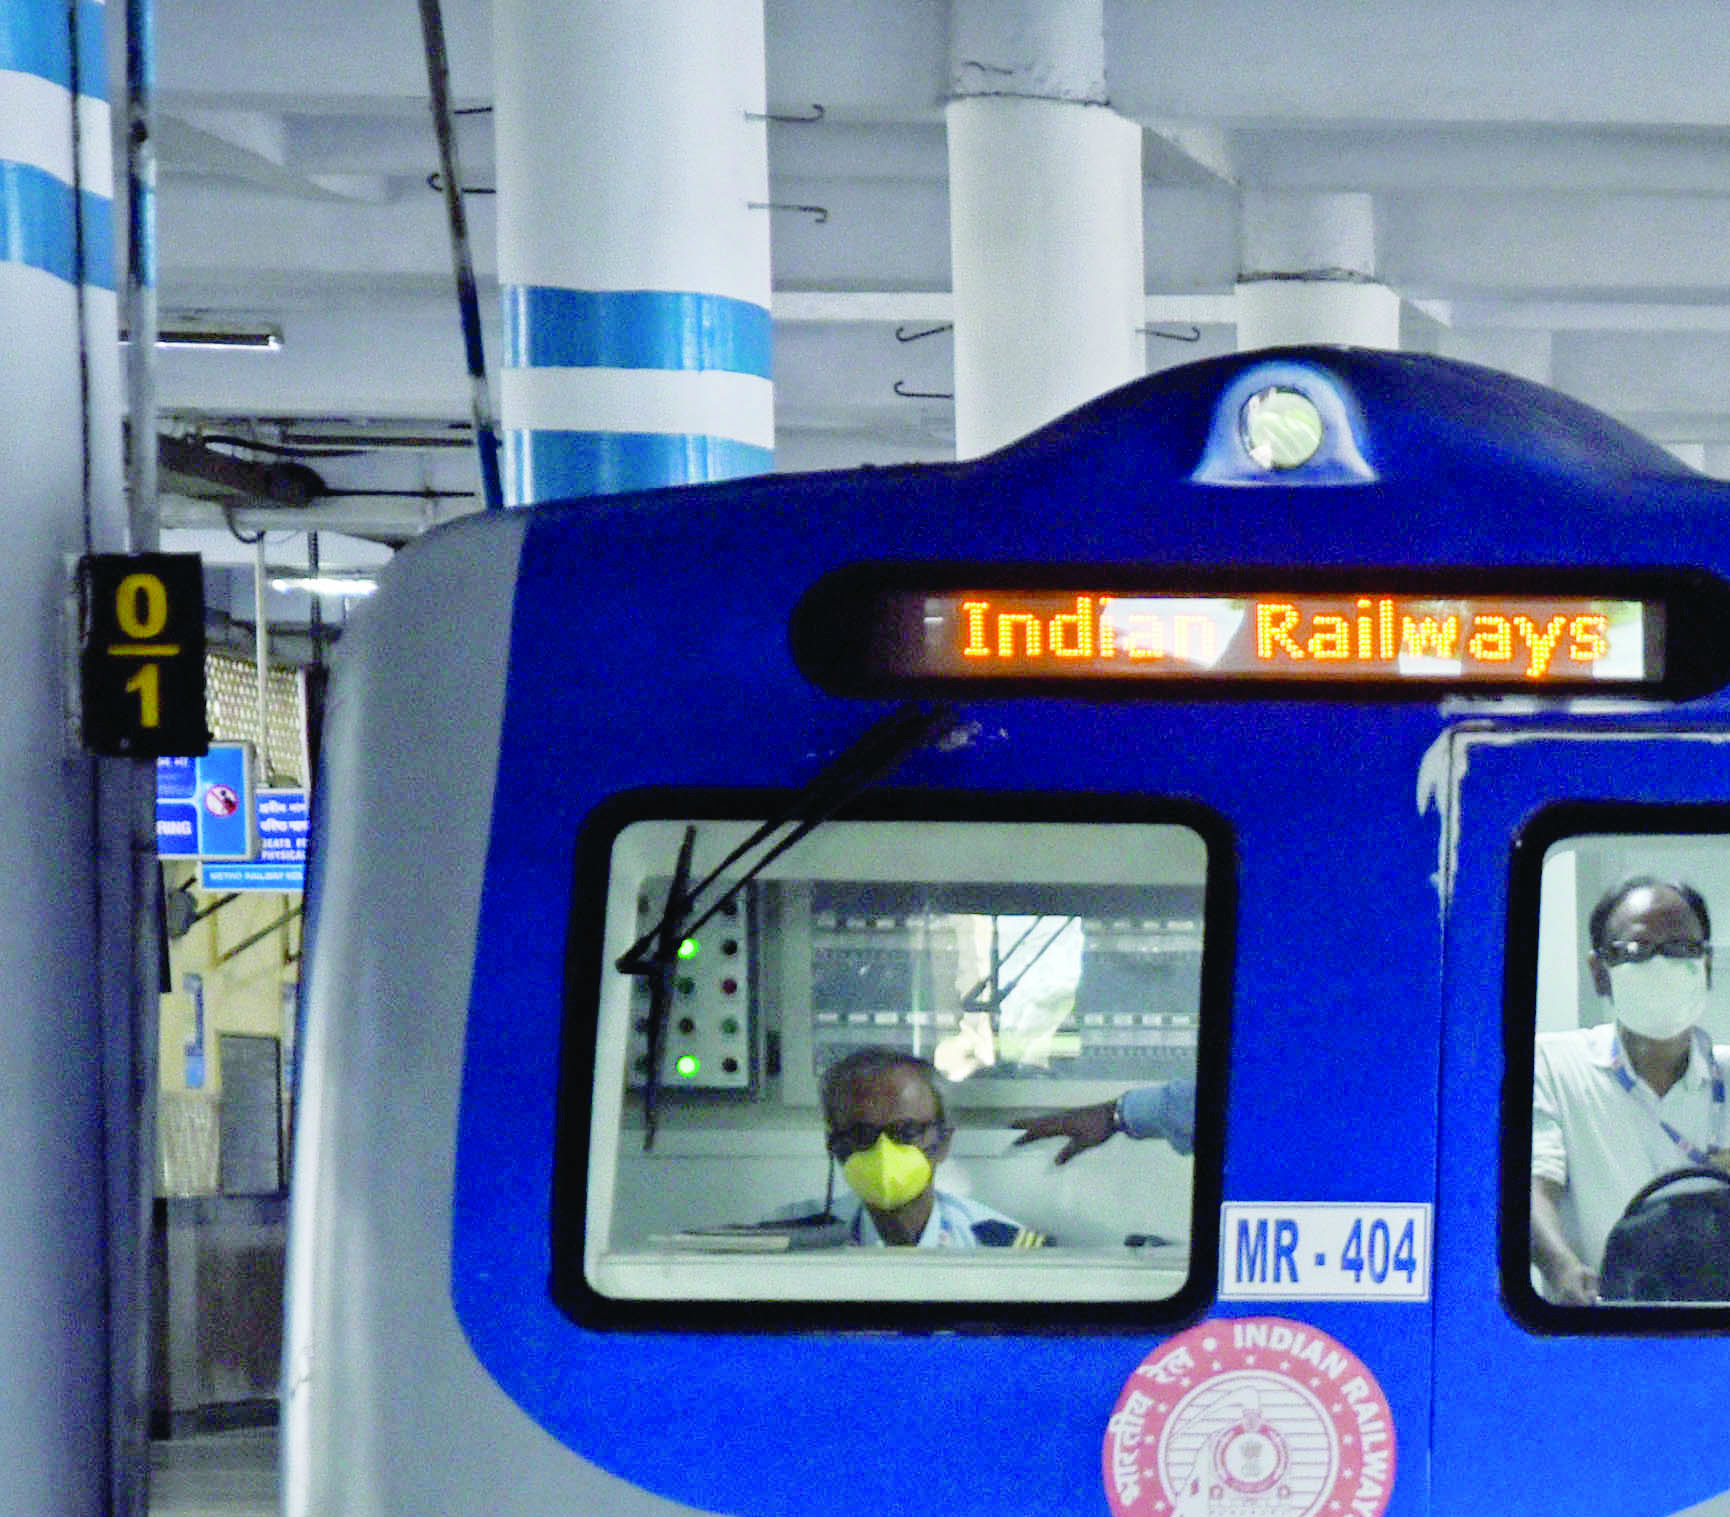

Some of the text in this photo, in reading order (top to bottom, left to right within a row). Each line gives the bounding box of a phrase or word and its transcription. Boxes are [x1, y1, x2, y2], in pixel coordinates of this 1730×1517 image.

[113, 573, 168, 639] 0
[963, 594, 1609, 679] Indian Railways
[124, 663, 161, 729] 1
[1235, 1218, 1299, 1284] MR
[1341, 1218, 1416, 1284] 404
[1232, 1323, 1348, 1380] INDIAN
[1110, 1346, 1195, 1507] भारतीय रेल
